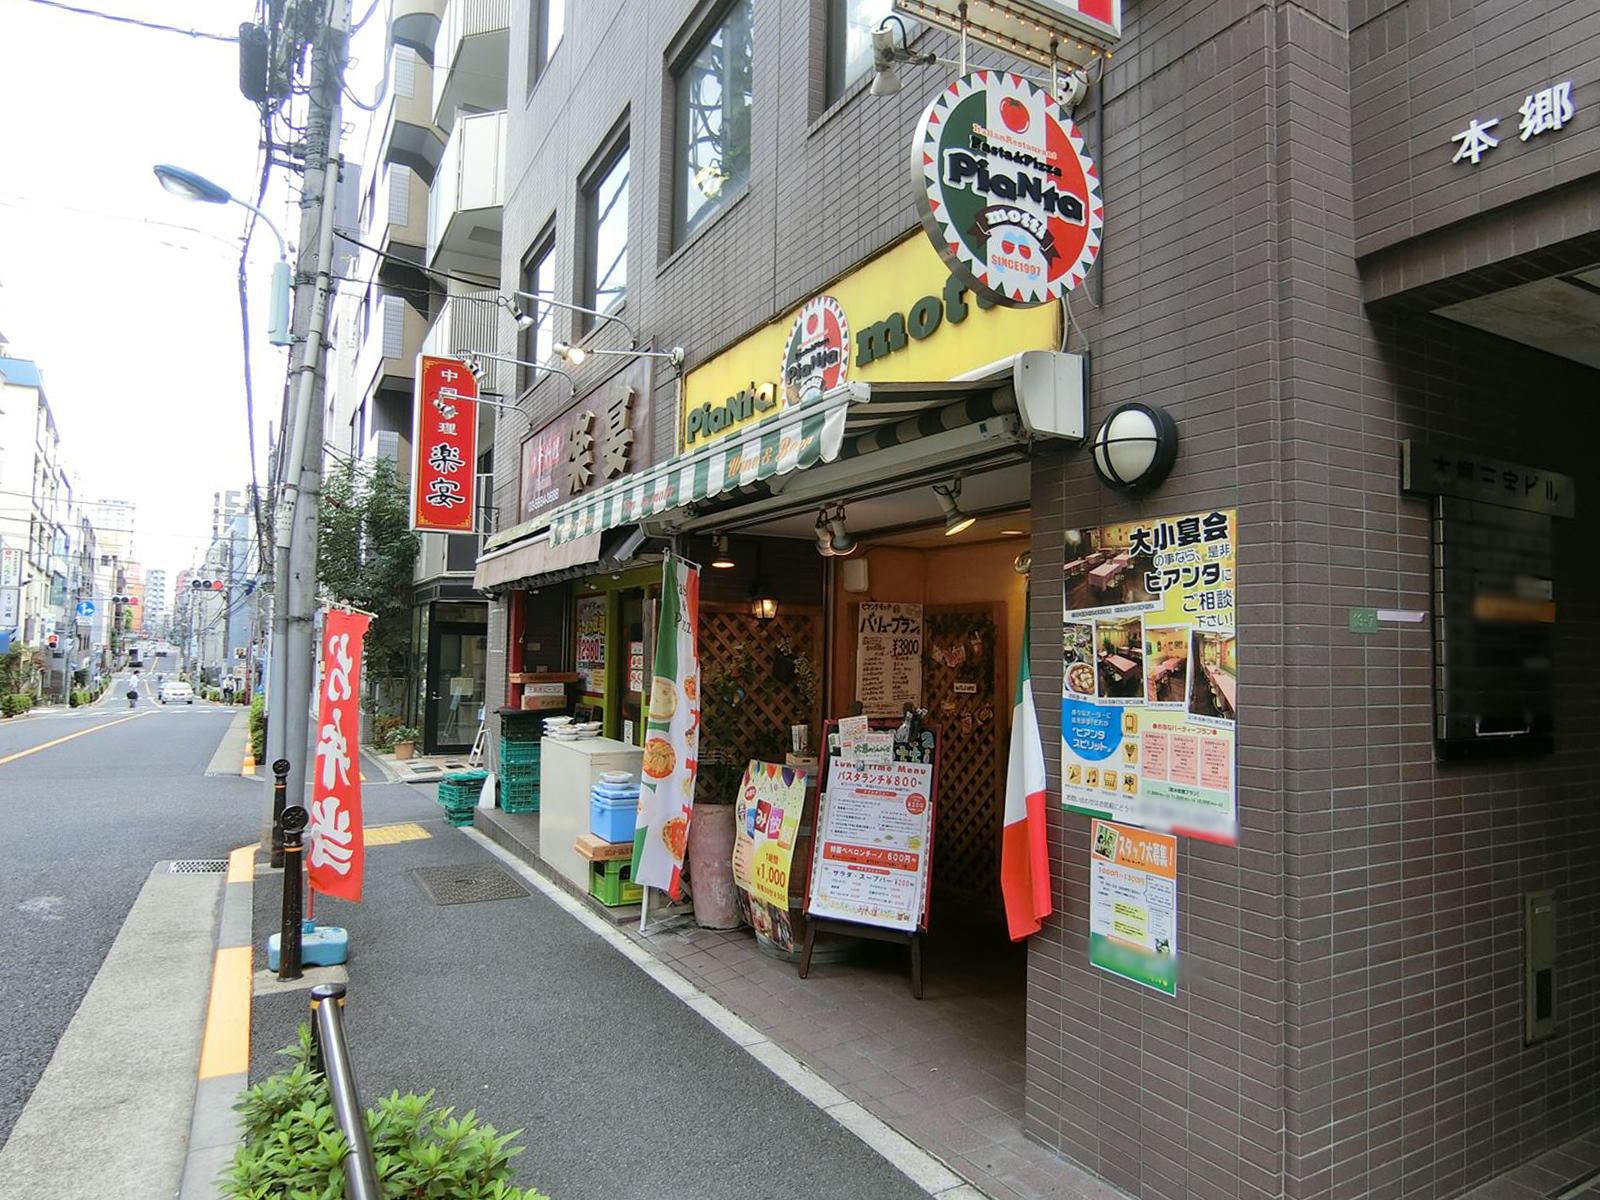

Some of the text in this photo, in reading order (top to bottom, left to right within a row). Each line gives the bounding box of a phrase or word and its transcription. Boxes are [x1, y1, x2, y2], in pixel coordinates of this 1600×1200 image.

[1451, 81, 1575, 164] 本郷
[945, 151, 1085, 223] PiaNta
[990, 253, 1042, 277] SINCE1997
[687, 382, 778, 444] PiaNta
[425, 442, 466, 509] 楽宴
[726, 453, 760, 478] Wine
[1129, 511, 1229, 556] 大小宴会
[1144, 562, 1233, 593] ピアンタに
[1182, 589, 1233, 613] ご相談
[892, 638, 919, 657] ¥3800
